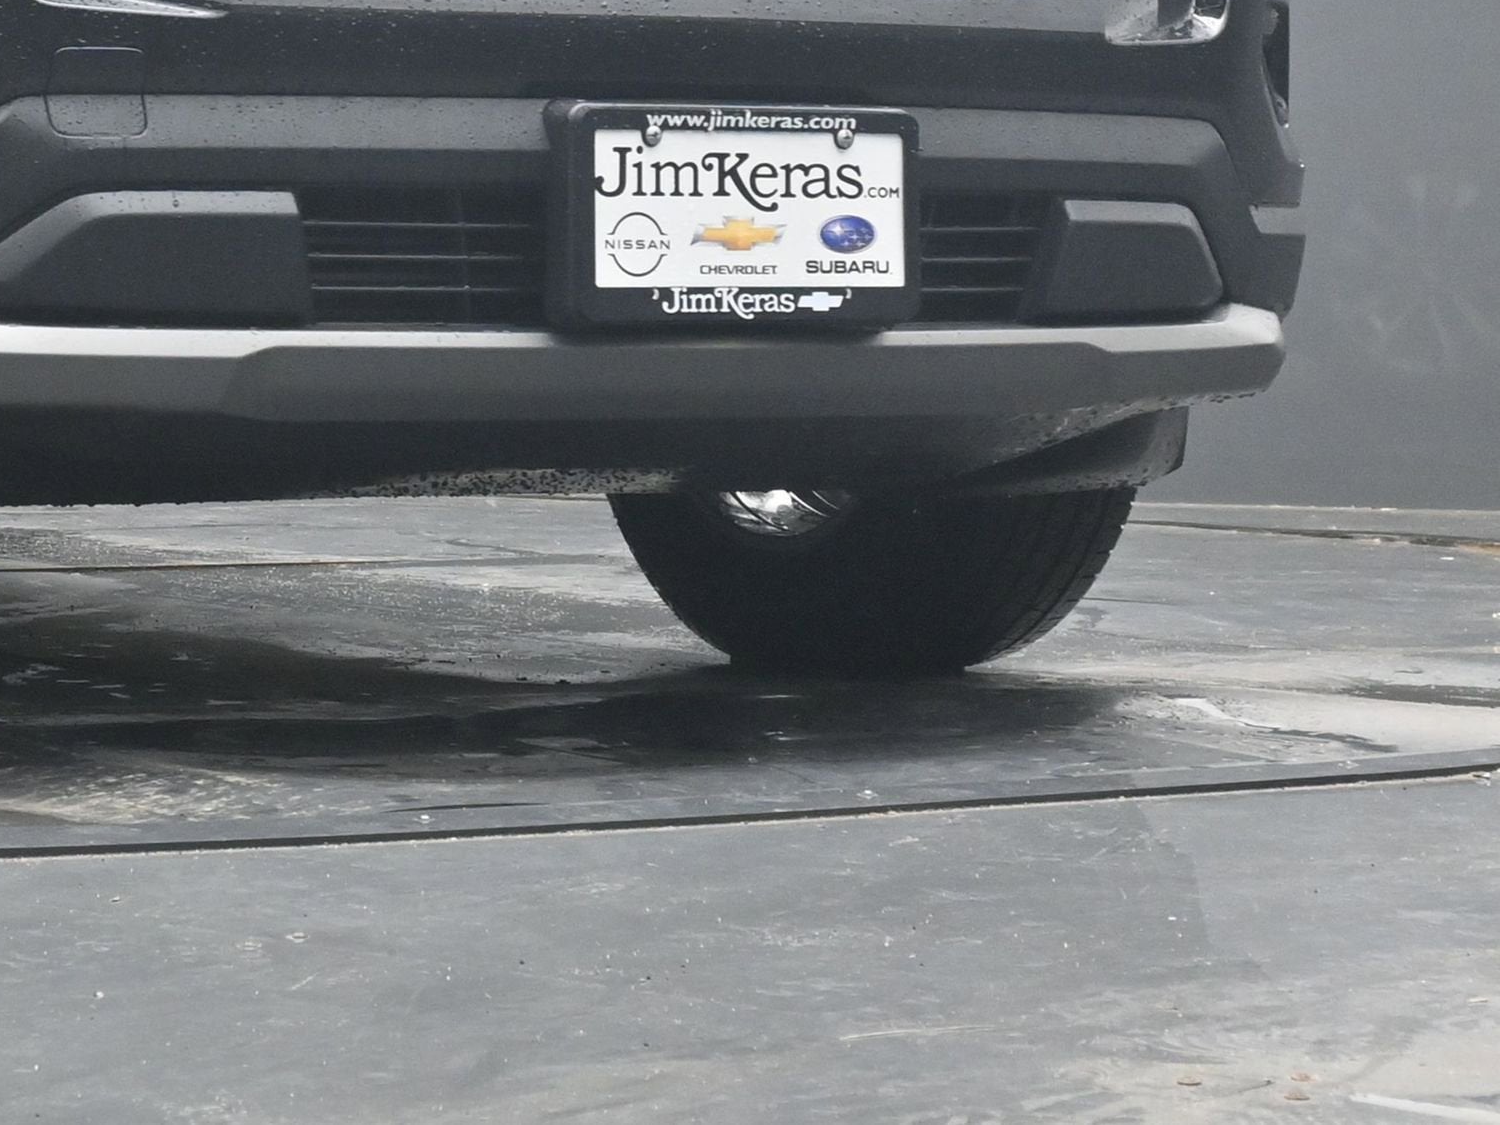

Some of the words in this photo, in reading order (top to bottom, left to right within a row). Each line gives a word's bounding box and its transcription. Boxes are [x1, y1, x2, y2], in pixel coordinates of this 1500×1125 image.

[646, 109, 857, 132] www.jimkeras.com
[604, 239, 671, 250] NISSAN
[699, 264, 778, 275] CHEVROLET
[805, 260, 890, 274] SUBARU
[661, 286, 796, 320] JimKeras
